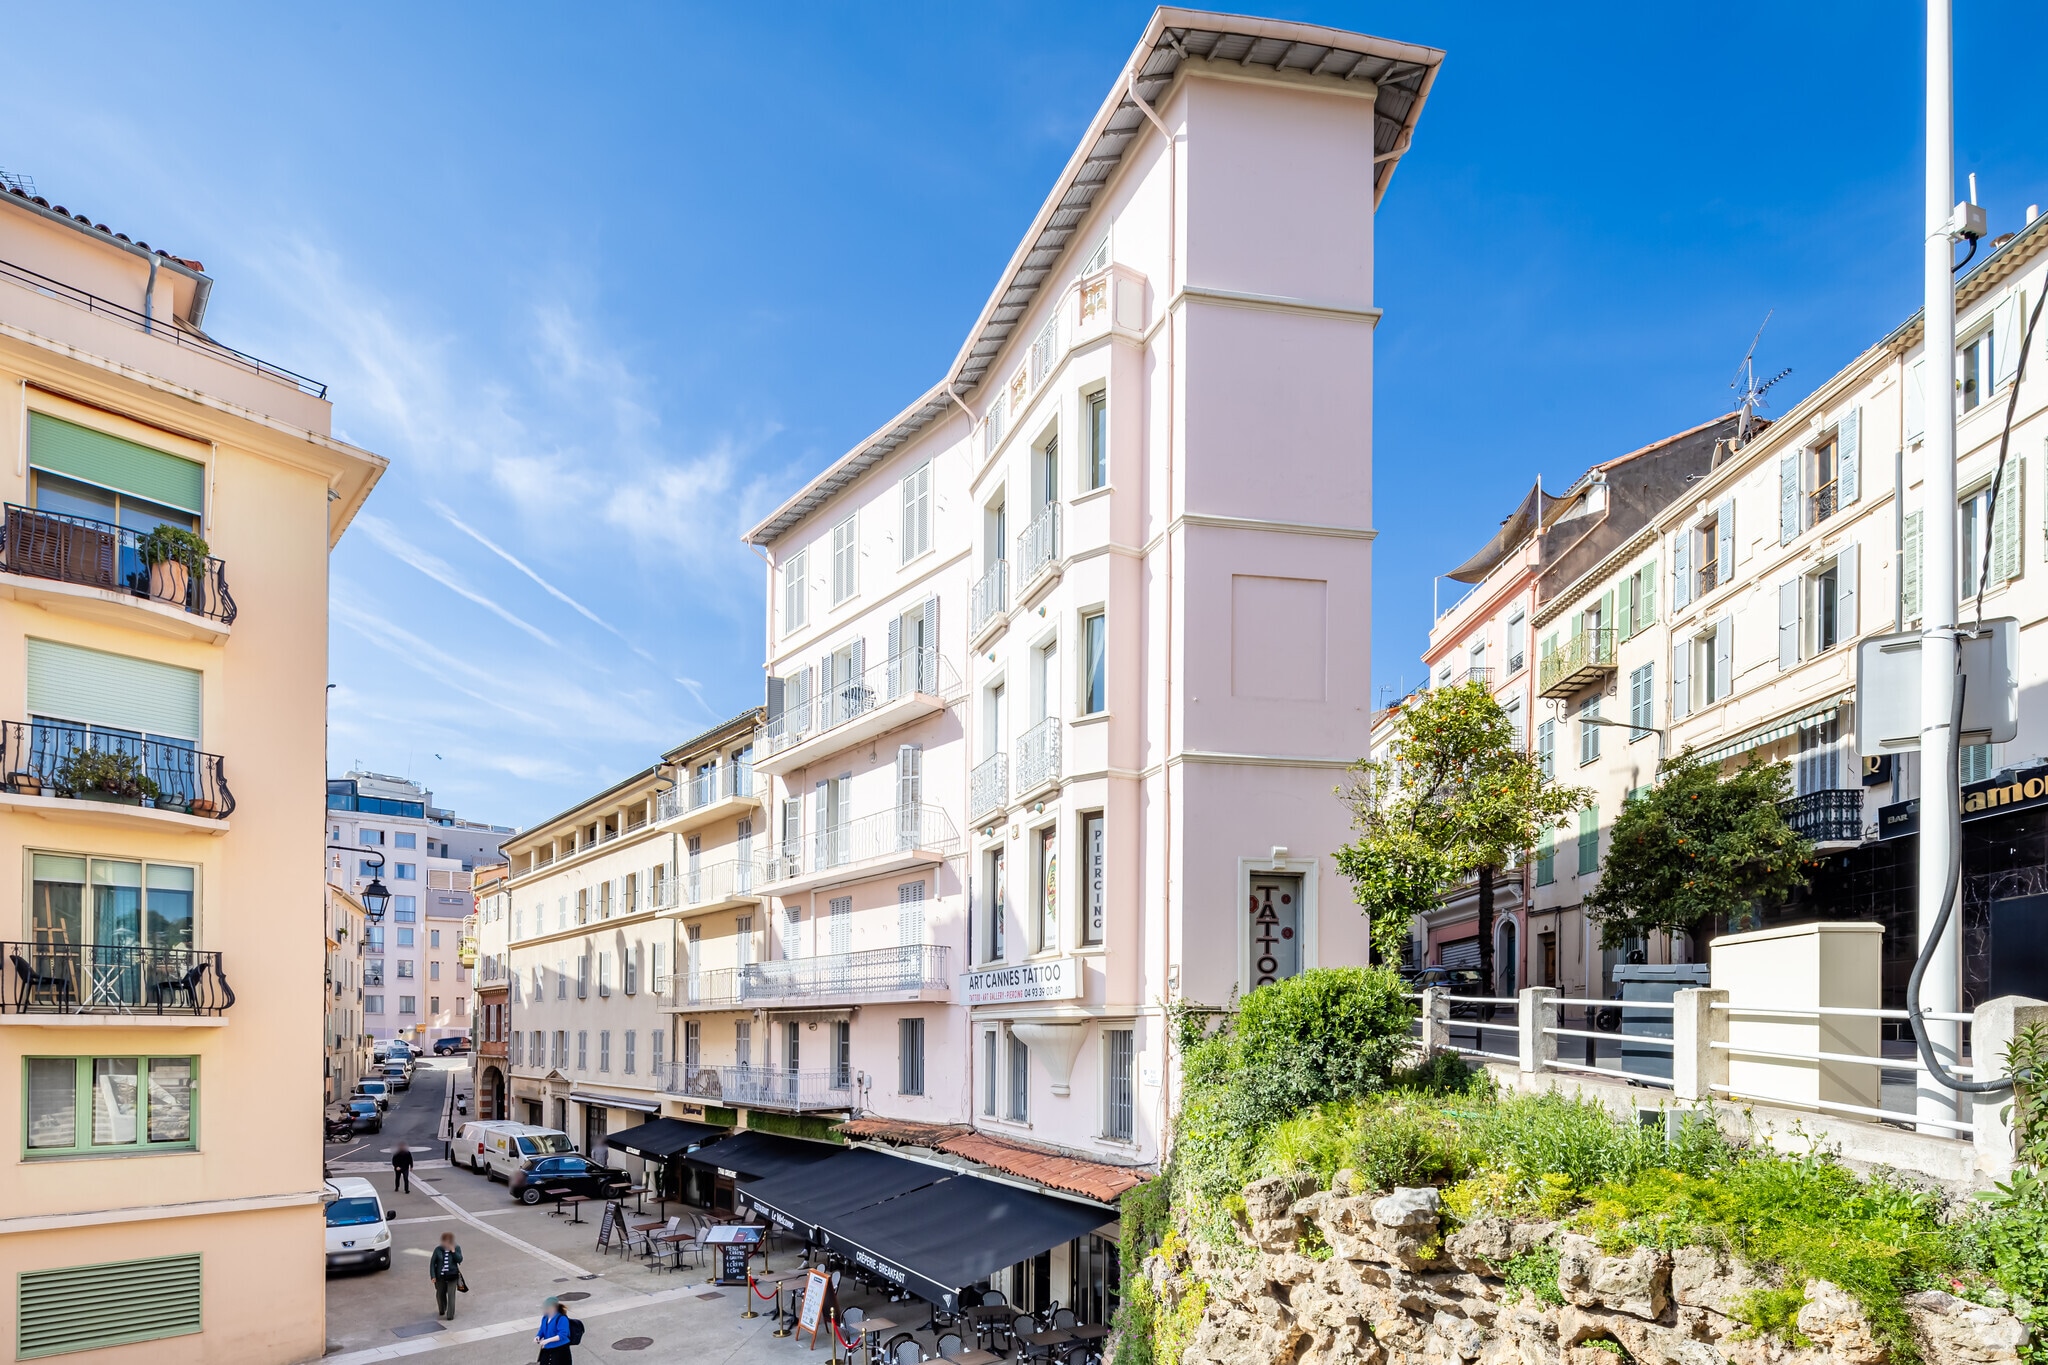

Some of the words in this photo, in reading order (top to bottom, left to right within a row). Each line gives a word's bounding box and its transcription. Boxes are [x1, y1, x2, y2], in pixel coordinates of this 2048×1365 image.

[1887, 813, 1908, 825] BAR
[1093, 829, 1102, 929] PIERCING
[969, 974, 983, 990] ART
[985, 969, 1020, 989] CANNES
[1022, 964, 1061, 984] TATTOO
[1024, 989, 1031, 998] 04
[1031, 988, 1038, 997] 93
[1038, 987, 1045, 997] 39
[1046, 986, 1053, 996] 00
[1054, 985, 1061, 995] 49
[771, 1210, 777, 1221] Le
[776, 1212, 794, 1230] Welcome
[856, 1251, 877, 1269] CRÊPERIE
[879, 1262, 905, 1284] BREAKFAST
